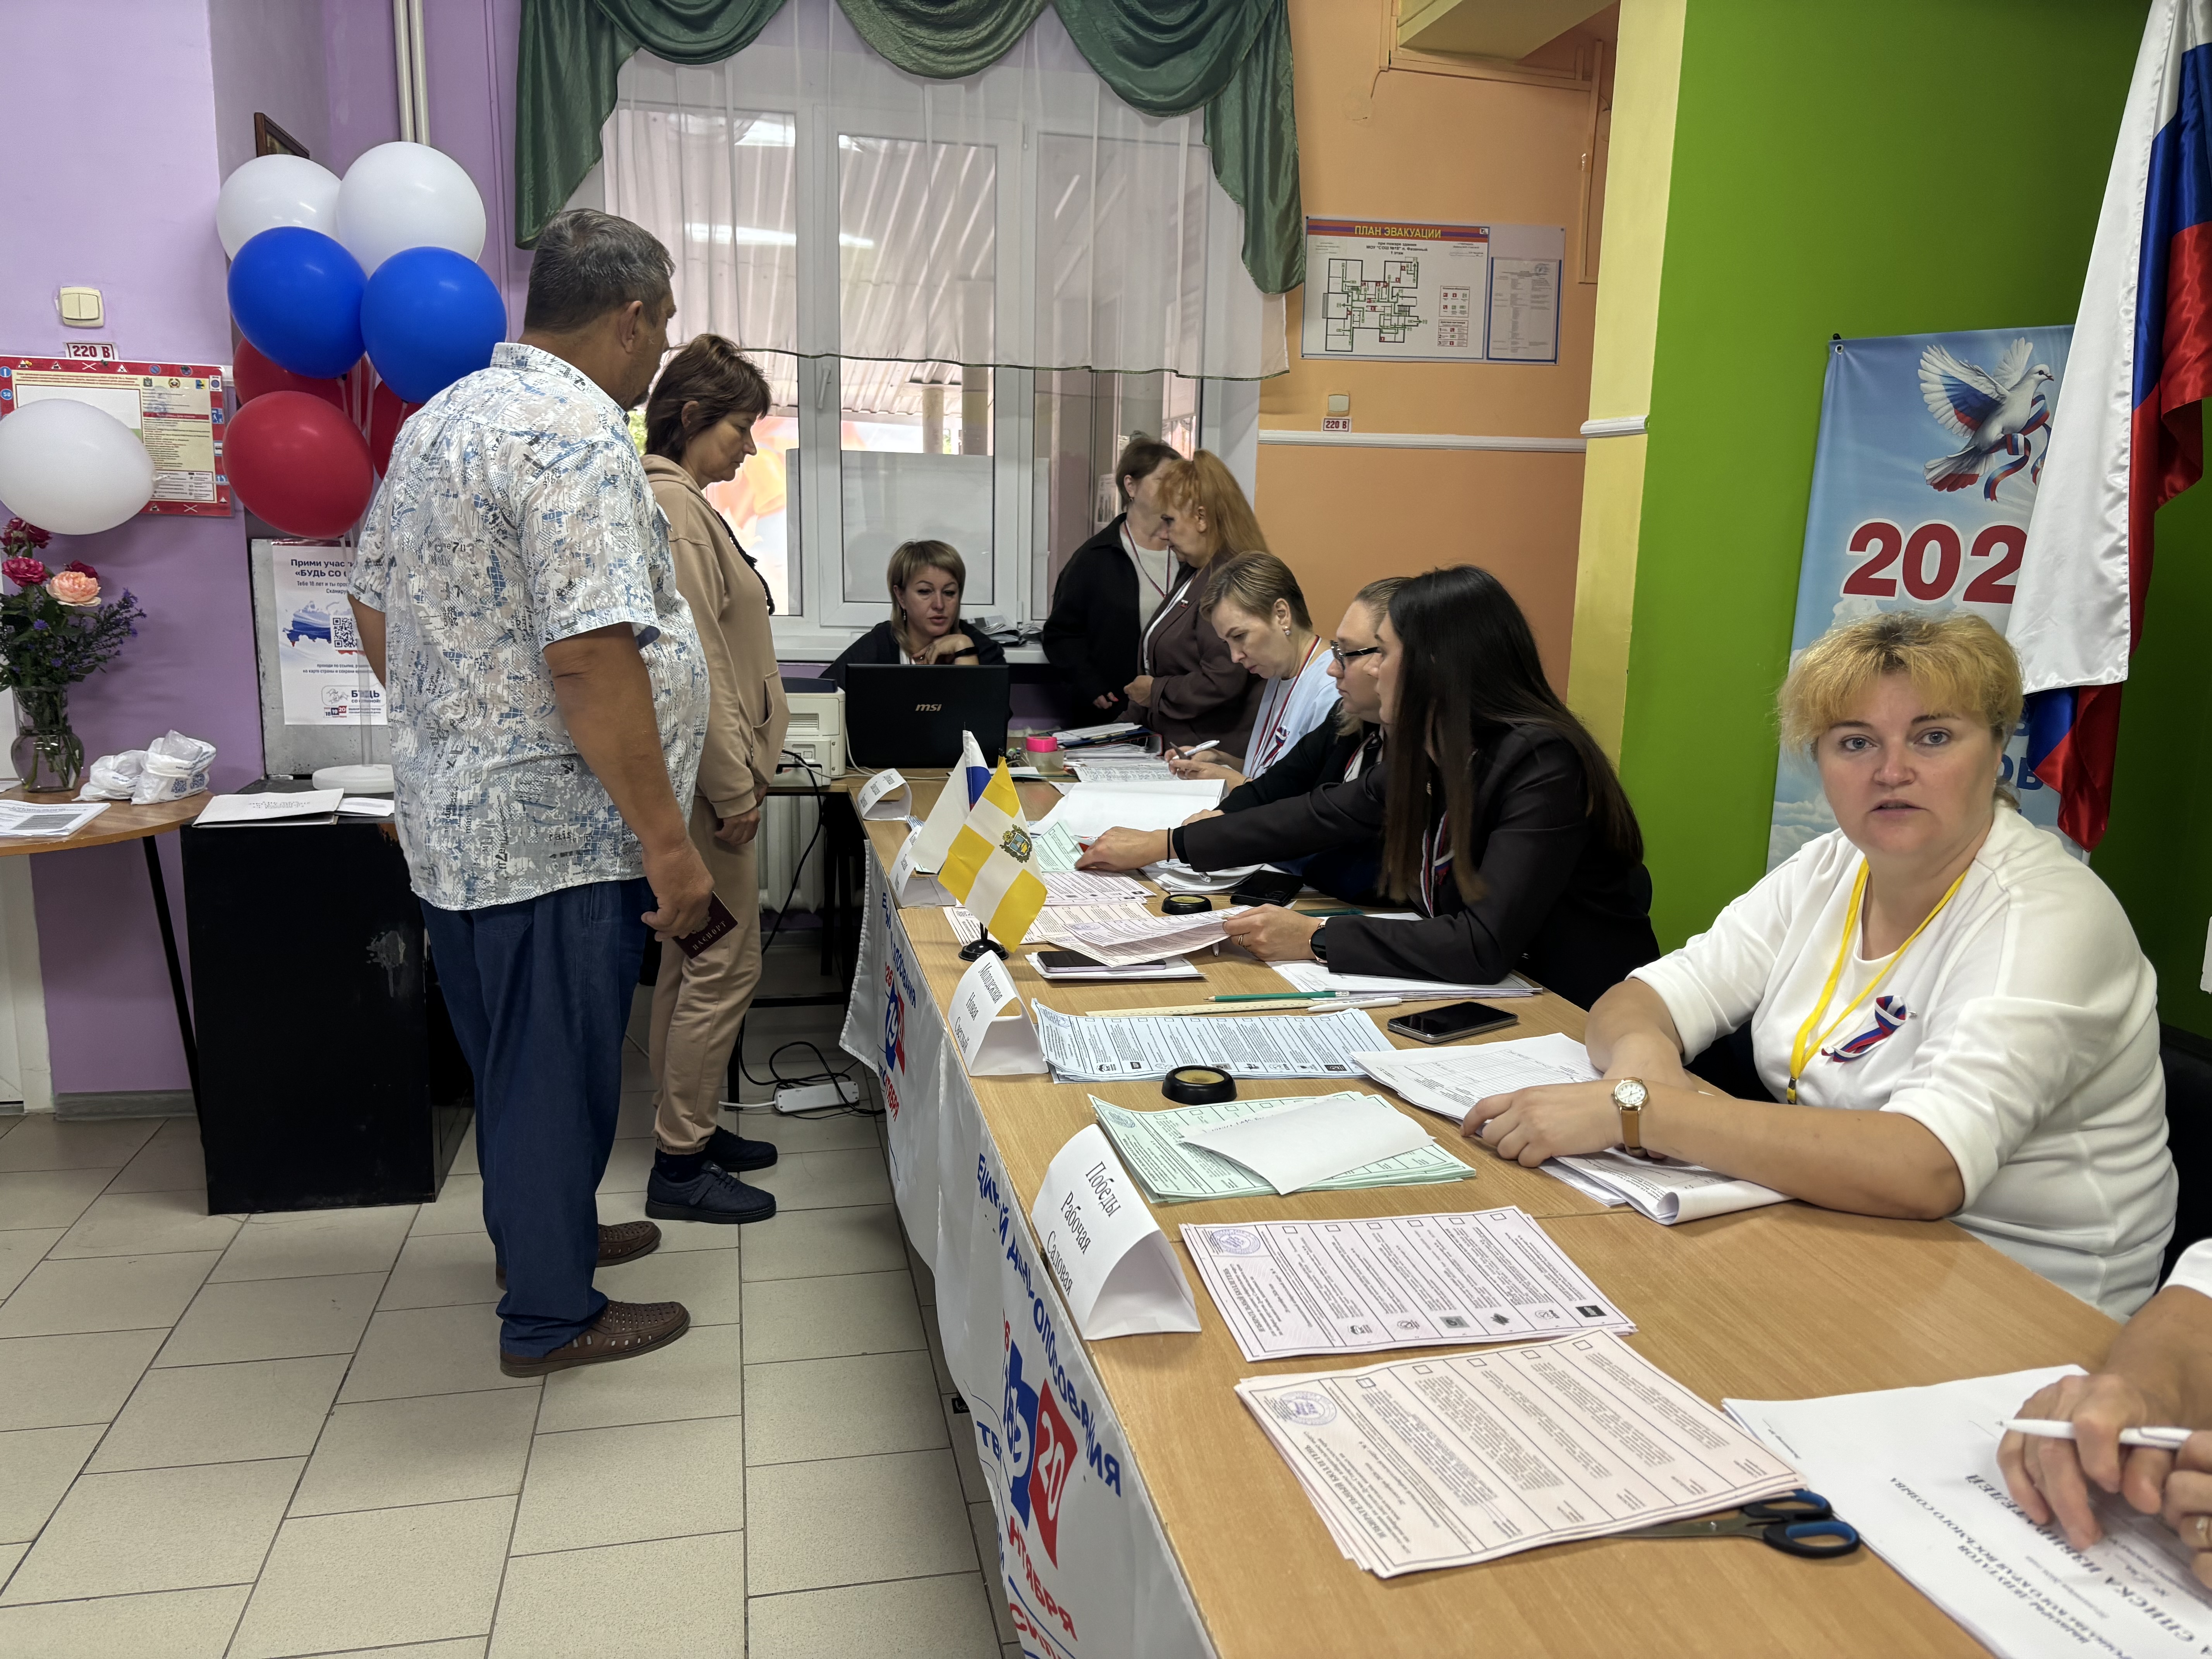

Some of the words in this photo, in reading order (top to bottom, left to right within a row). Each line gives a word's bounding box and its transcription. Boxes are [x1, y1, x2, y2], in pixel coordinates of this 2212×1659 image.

[1355, 226, 1381, 235] ПЛАН
[1384, 227, 1441, 239] ЭВАКУАЦИИ
[72, 345, 97, 357] 220
[102, 346, 111, 358] В
[1326, 421, 1340, 429] 220
[291, 559, 321, 567] Прими
[1843, 522, 2028, 605] 202
[692, 920, 727, 951] ПАСПОРТ
[966, 991, 979, 1021] Новая
[955, 1017, 969, 1053] Светлый
[1085, 1161, 1121, 1218] Победы
[1060, 1190, 1091, 1255] Рабочая
[1047, 1230, 1073, 1297] Садовая
[1037, 1410, 1065, 1522] 20
[1890, 1477, 1934, 1511] СОЗЫВА
[1009, 1515, 1078, 1642] НТЯБРЯ
[2105, 1575, 2195, 1642] СПИСКА
